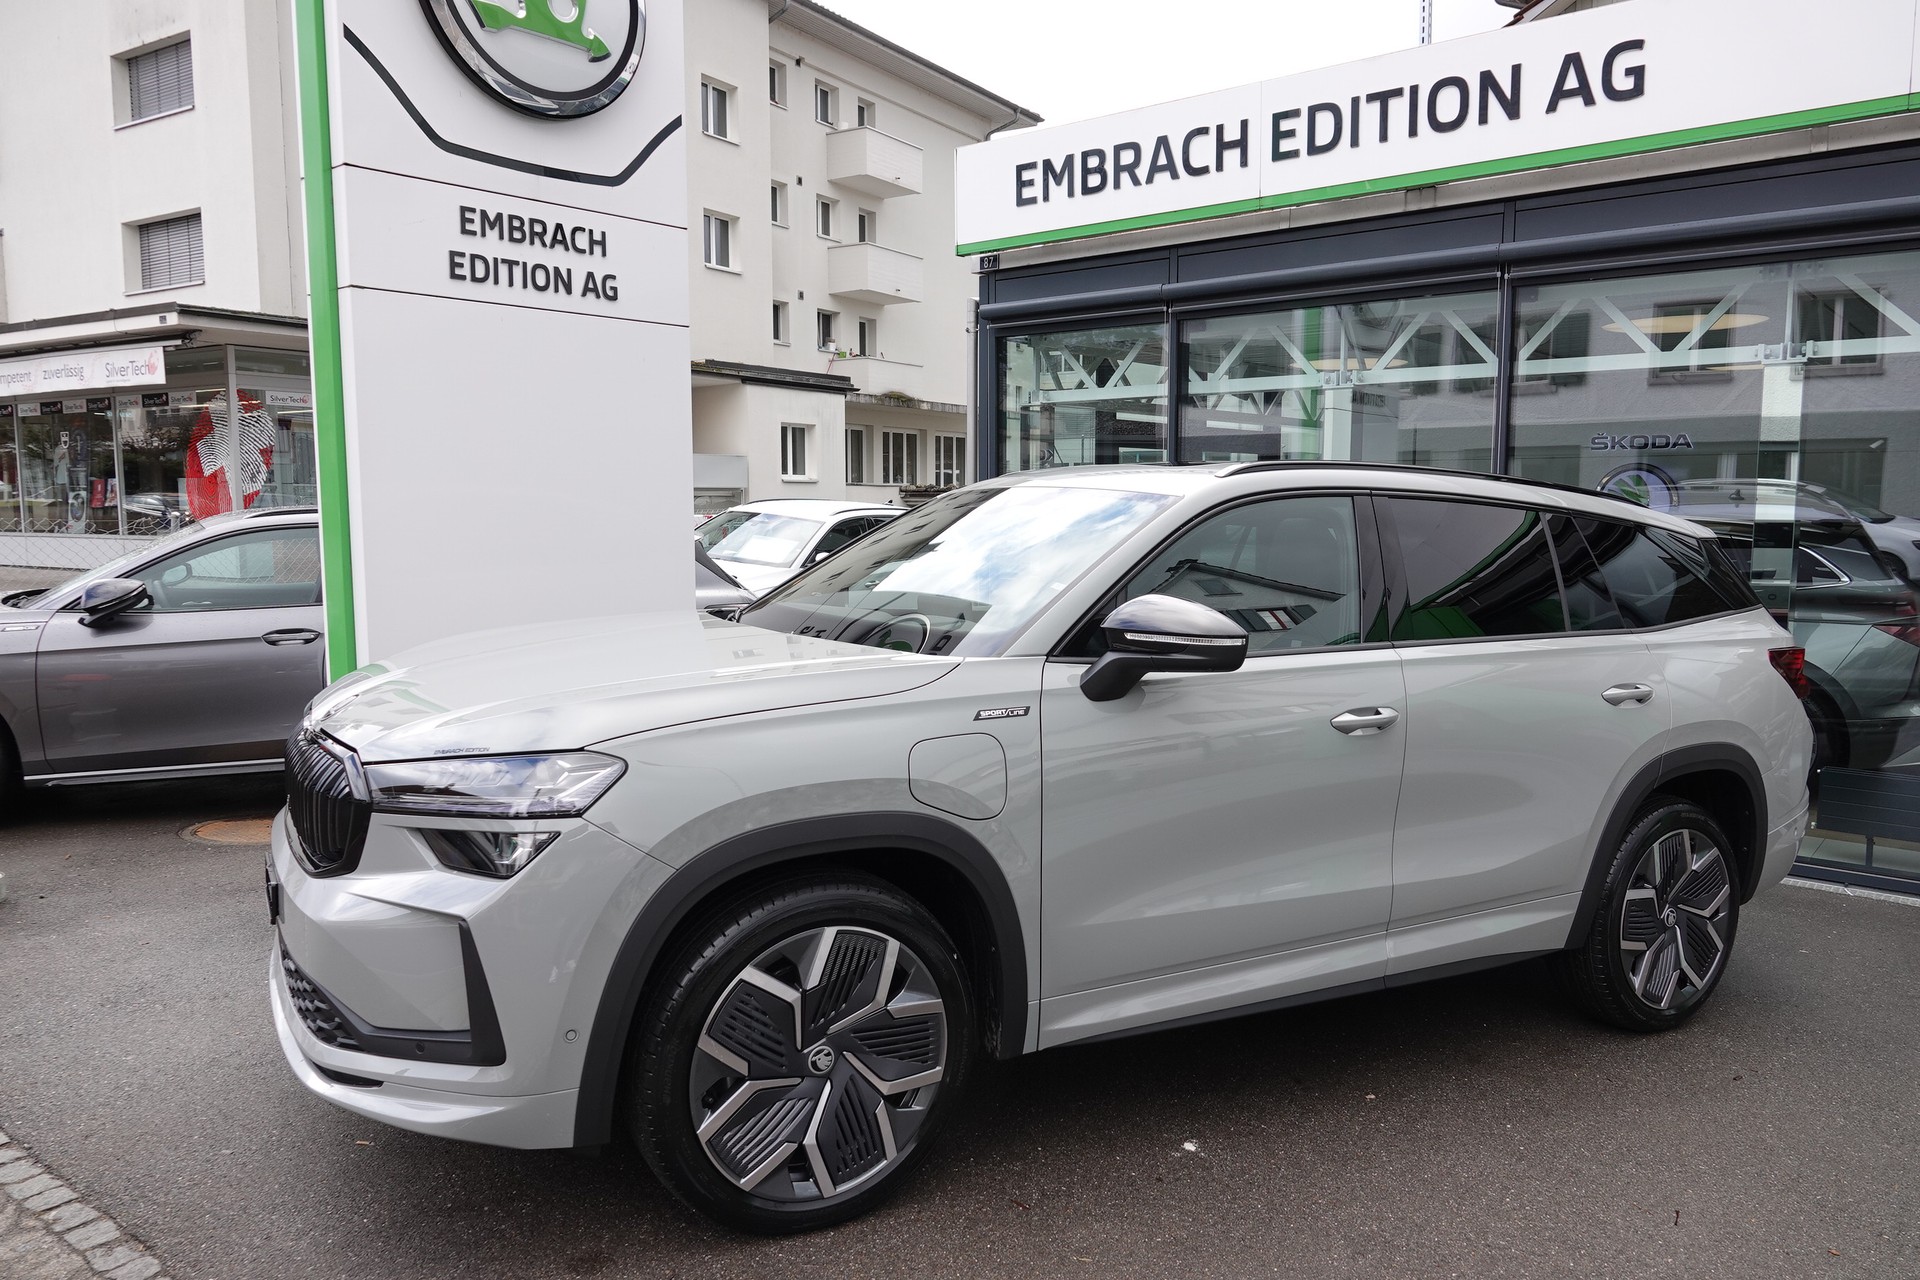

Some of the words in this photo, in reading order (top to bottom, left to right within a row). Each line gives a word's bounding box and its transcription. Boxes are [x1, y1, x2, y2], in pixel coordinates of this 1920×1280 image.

[1015, 118, 1249, 207] EMBRACH
[1270, 63, 1522, 163] EDITION
[1546, 38, 1646, 114] AG
[459, 205, 607, 257] EMBRACH
[983, 256, 994, 269] 87
[449, 250, 572, 295] EDITION
[581, 271, 618, 302] AG
[42, 363, 85, 381] zuverlässig
[105, 360, 149, 378] SilverTech
[270, 394, 304, 404] SilverTech
[1590, 432, 1693, 450] ŠKODA
